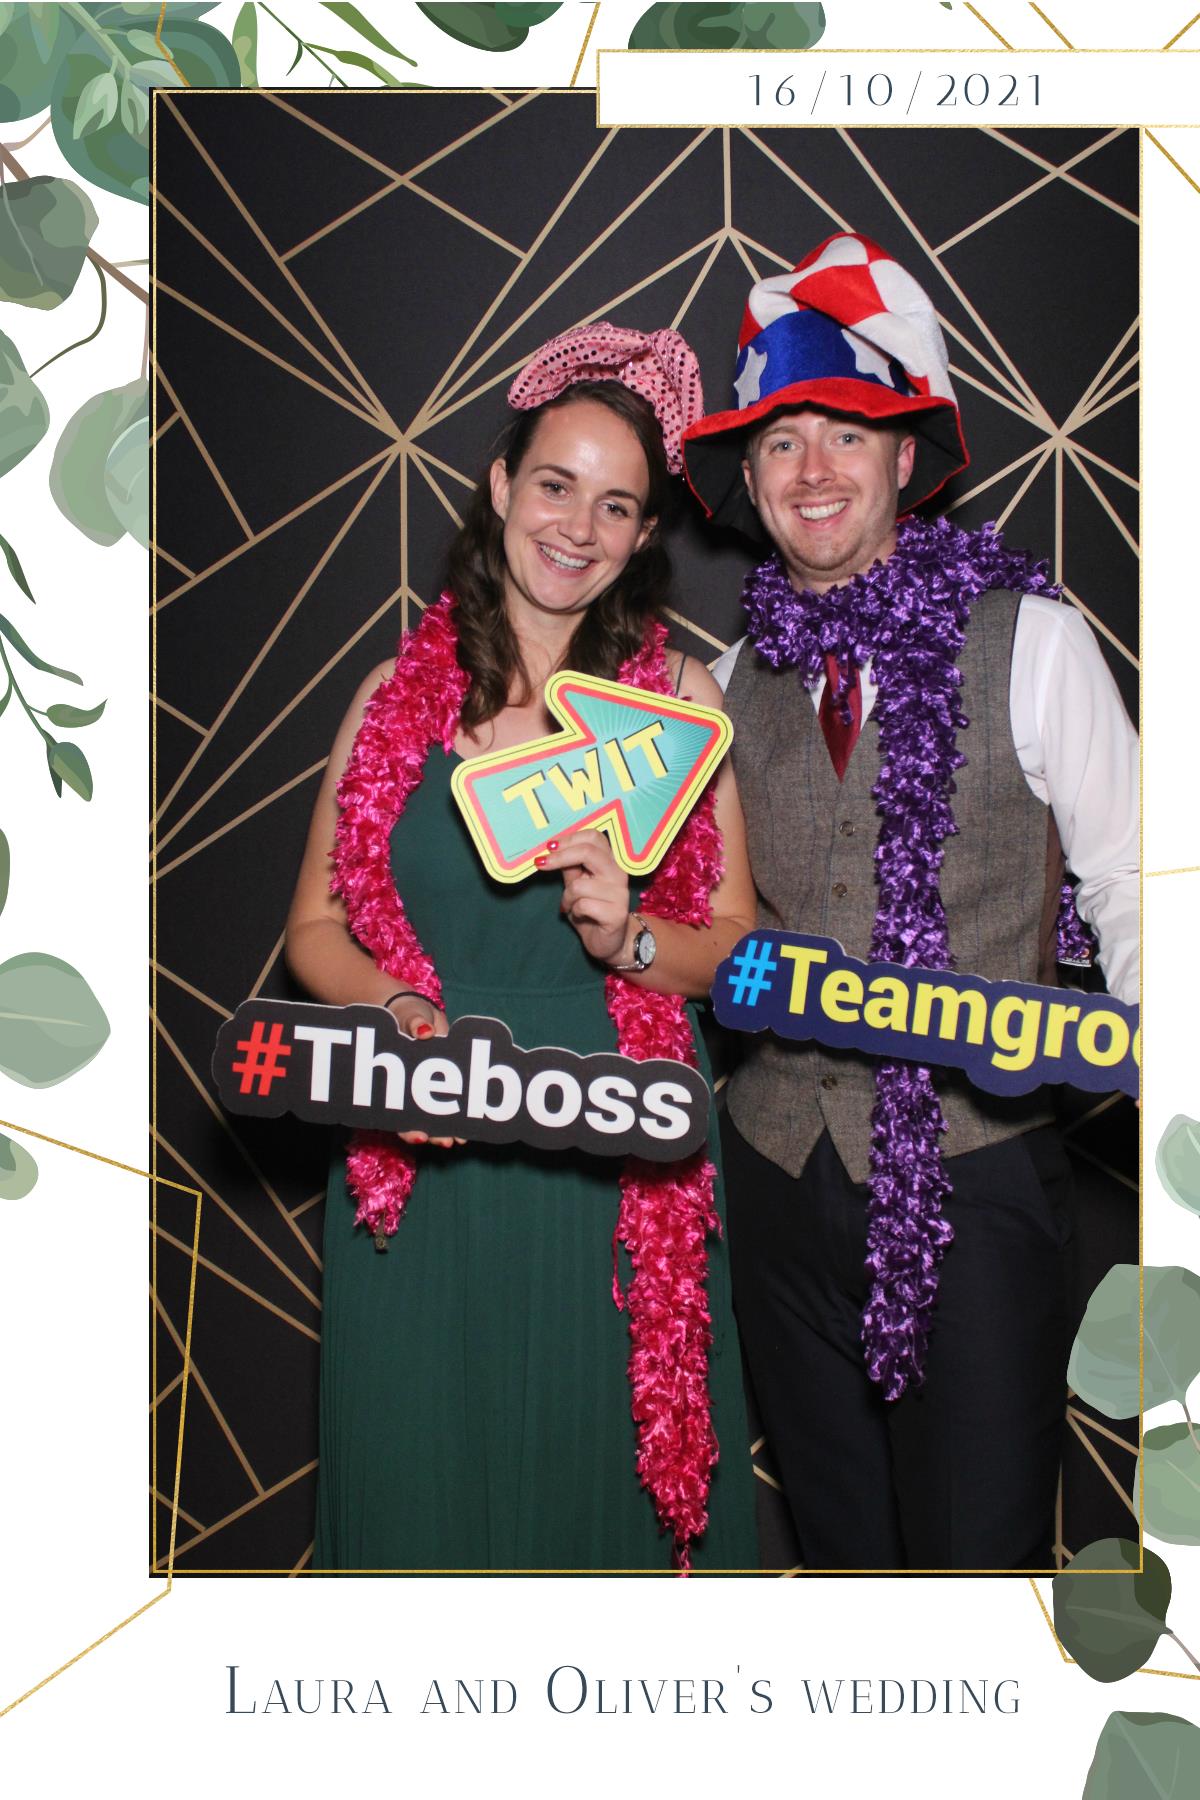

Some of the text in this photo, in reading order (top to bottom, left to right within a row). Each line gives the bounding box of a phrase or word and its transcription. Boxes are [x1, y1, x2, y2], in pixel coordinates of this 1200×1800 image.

[501, 719, 669, 830] TWIT
[728, 939, 1140, 1071] #Teamgro
[232, 1021, 692, 1140] #Theboss
